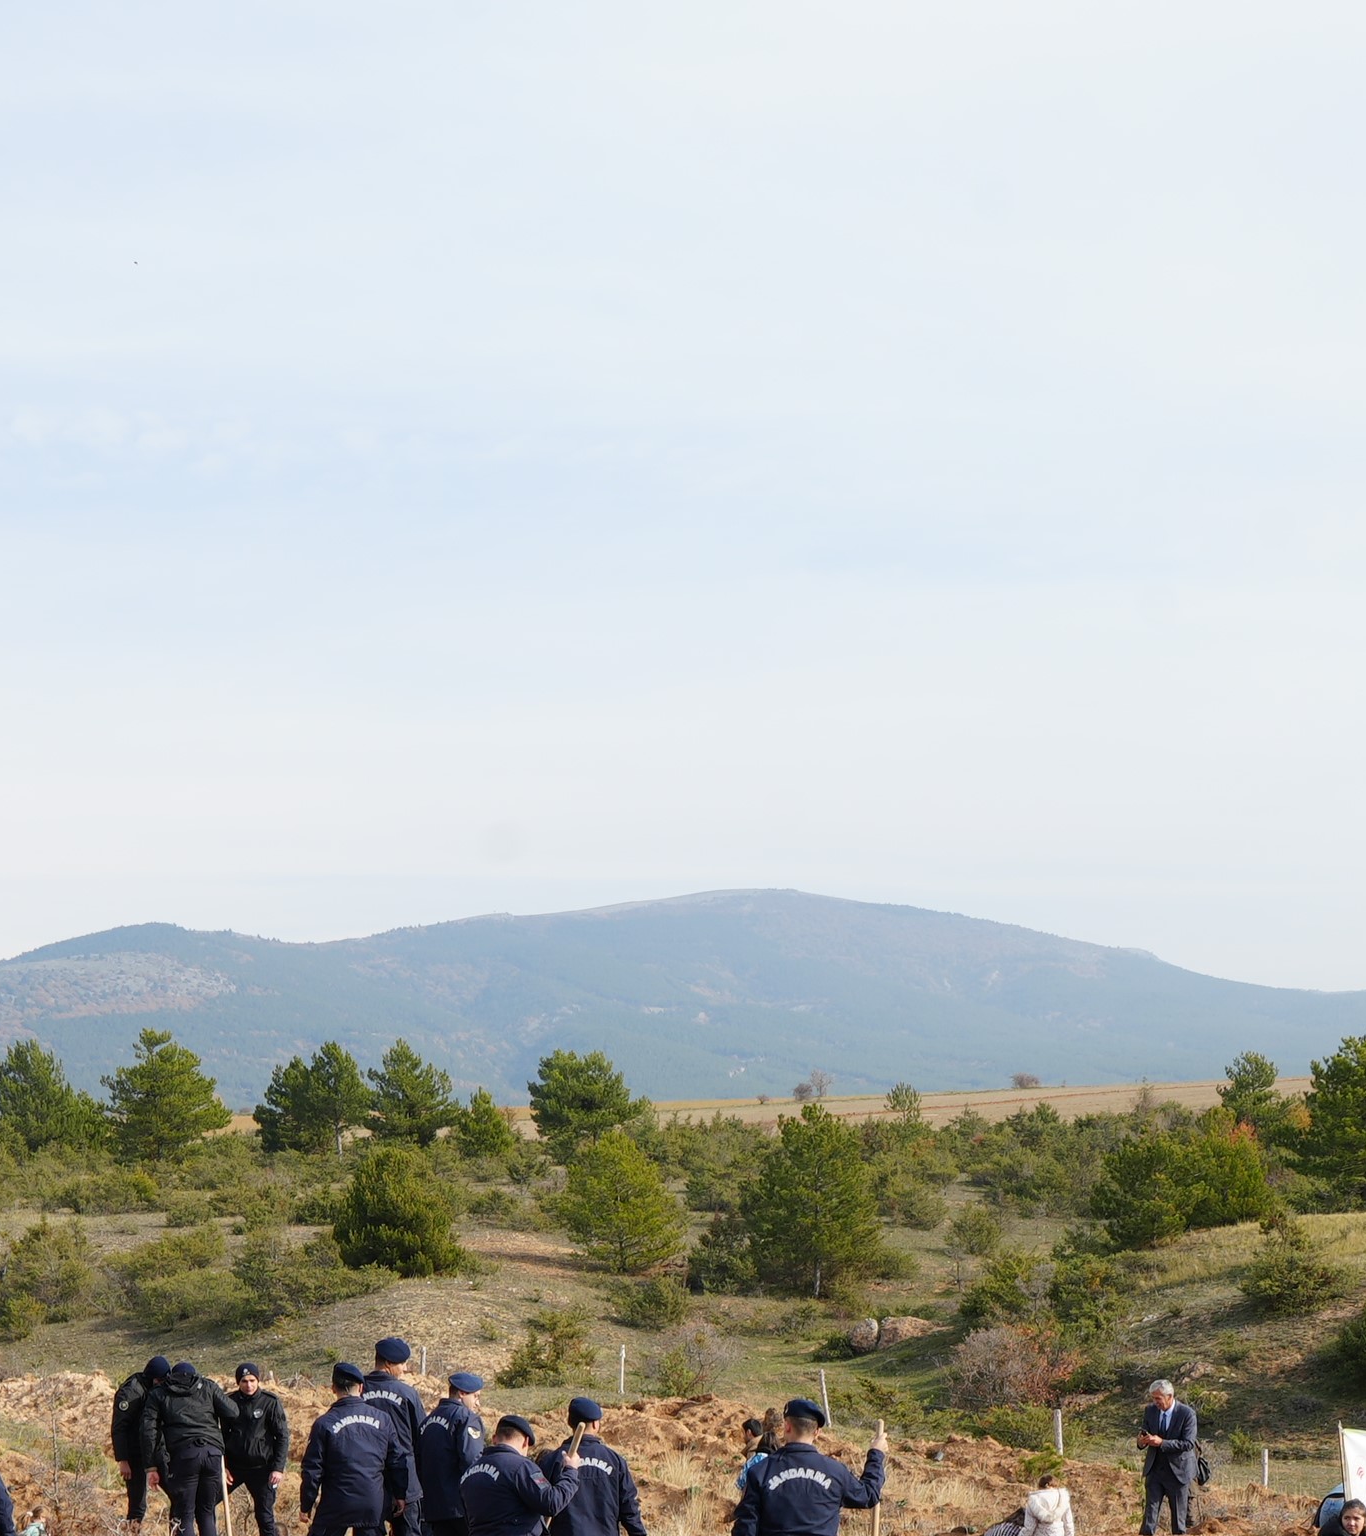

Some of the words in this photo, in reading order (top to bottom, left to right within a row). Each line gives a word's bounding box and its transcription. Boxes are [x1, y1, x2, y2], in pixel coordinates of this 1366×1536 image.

[363, 1390, 403, 1405] NDARMA
[332, 1414, 380, 1434] JANDARMA
[579, 1456, 613, 1475] DARMA
[768, 1467, 832, 1491] JANDARMA
